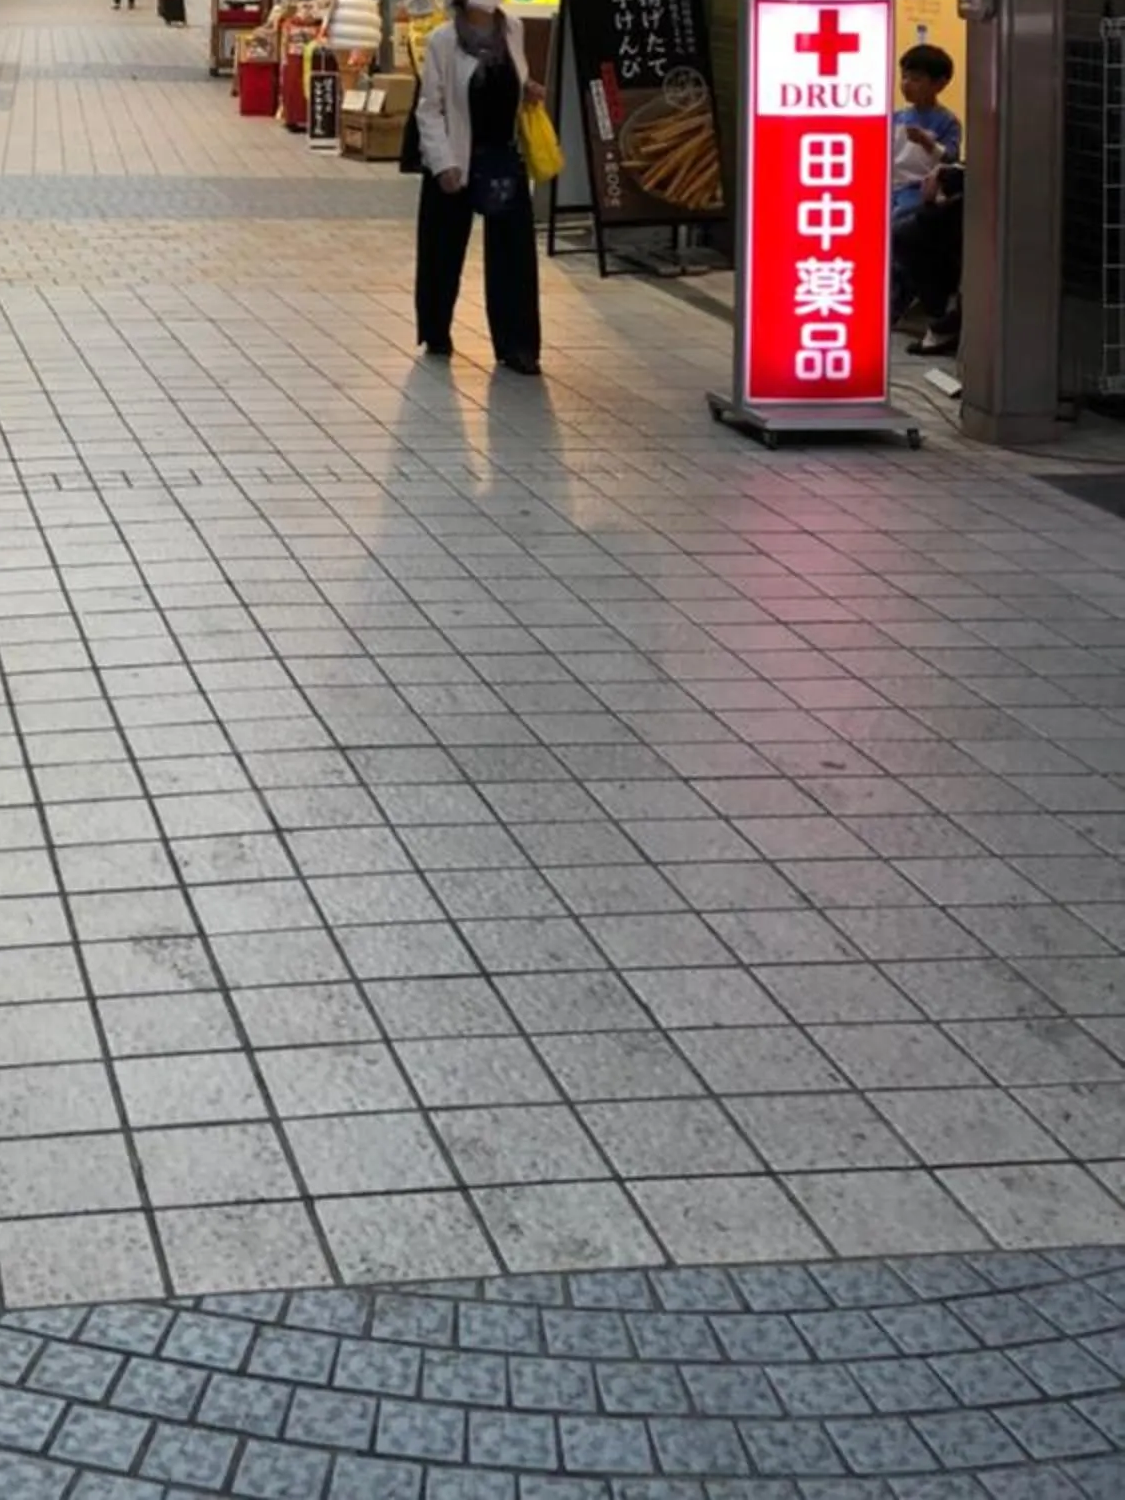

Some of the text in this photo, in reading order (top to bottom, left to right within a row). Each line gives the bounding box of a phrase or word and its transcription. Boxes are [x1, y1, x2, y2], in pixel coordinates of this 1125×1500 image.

[778, 82, 875, 109] DRUG
[794, 131, 855, 381] 田中薬品
